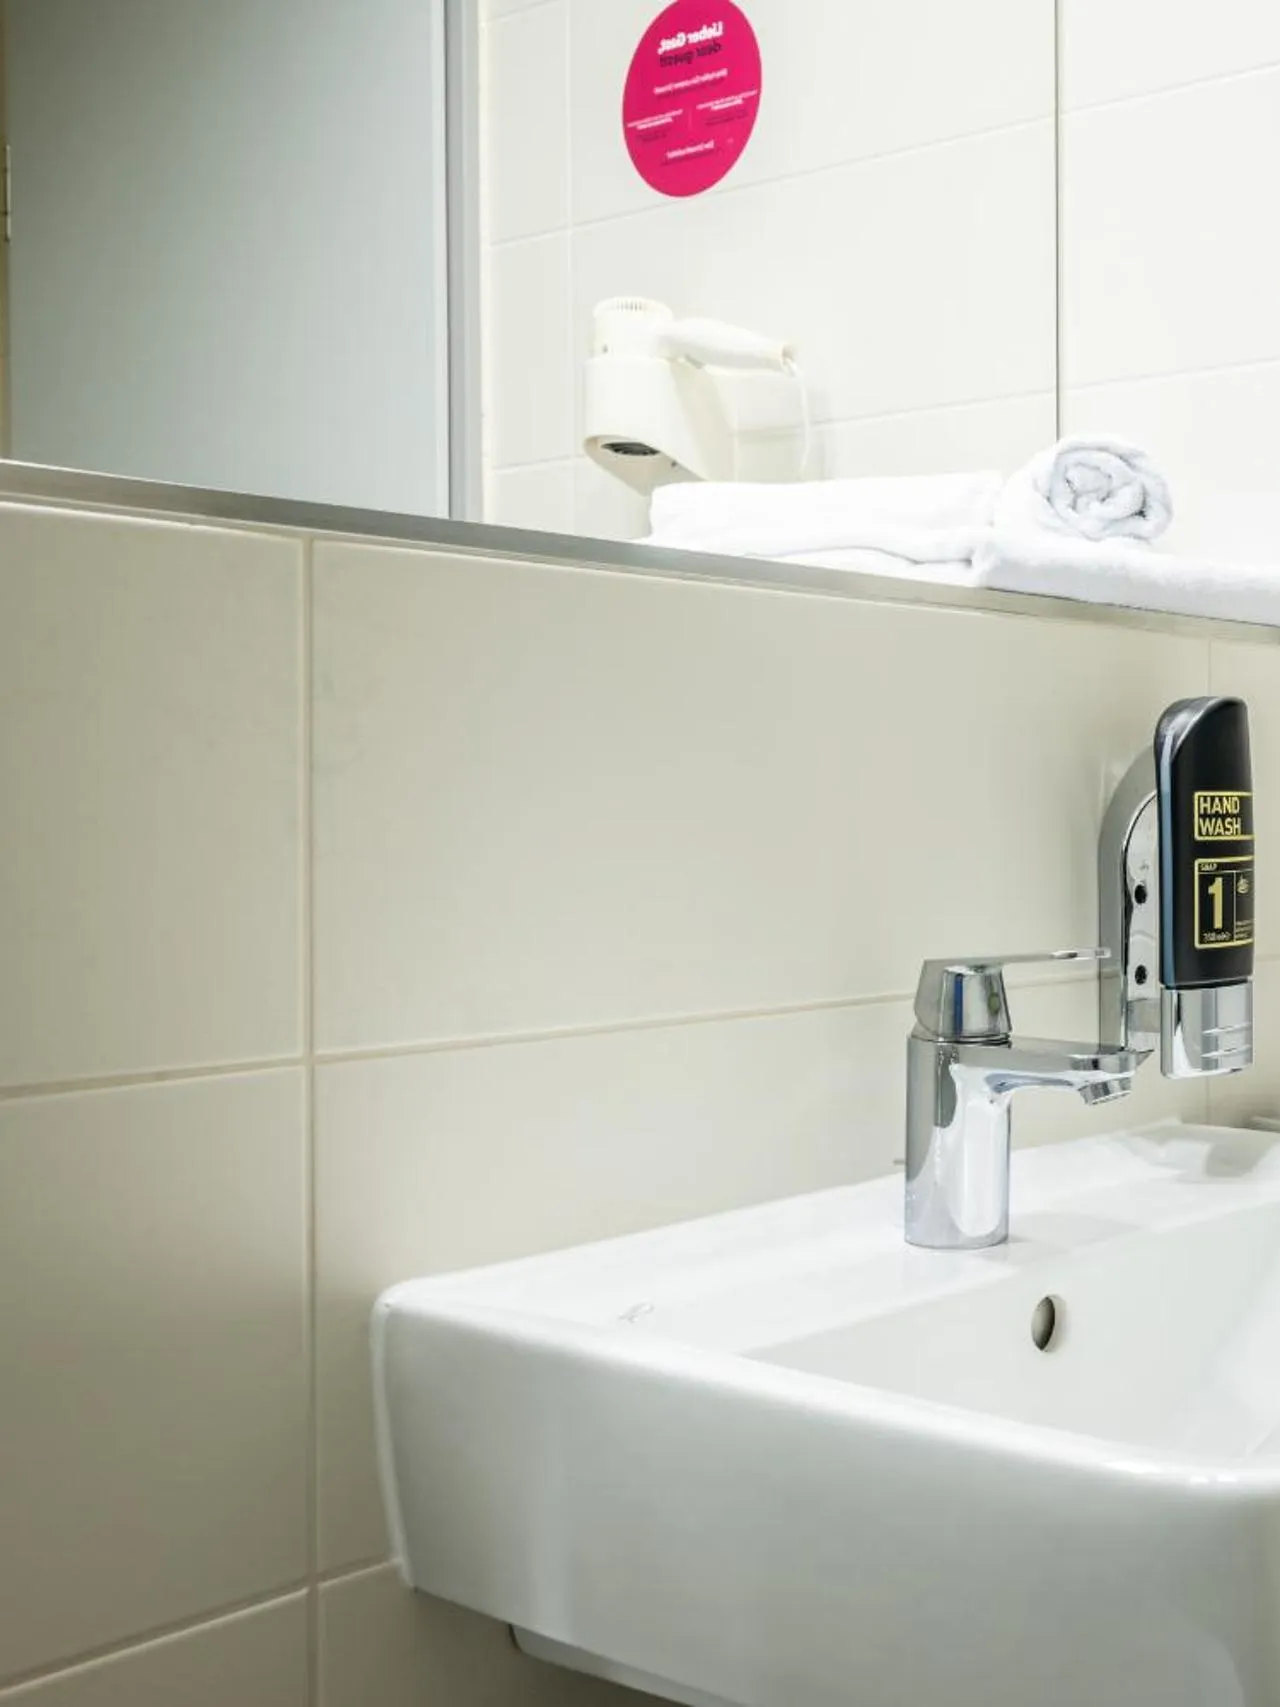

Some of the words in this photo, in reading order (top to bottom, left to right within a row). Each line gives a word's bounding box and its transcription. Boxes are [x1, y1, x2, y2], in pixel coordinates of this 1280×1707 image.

[1200, 796, 1241, 816] HAND
[1200, 817, 1242, 836] WASH
[1208, 877, 1223, 929] 1
